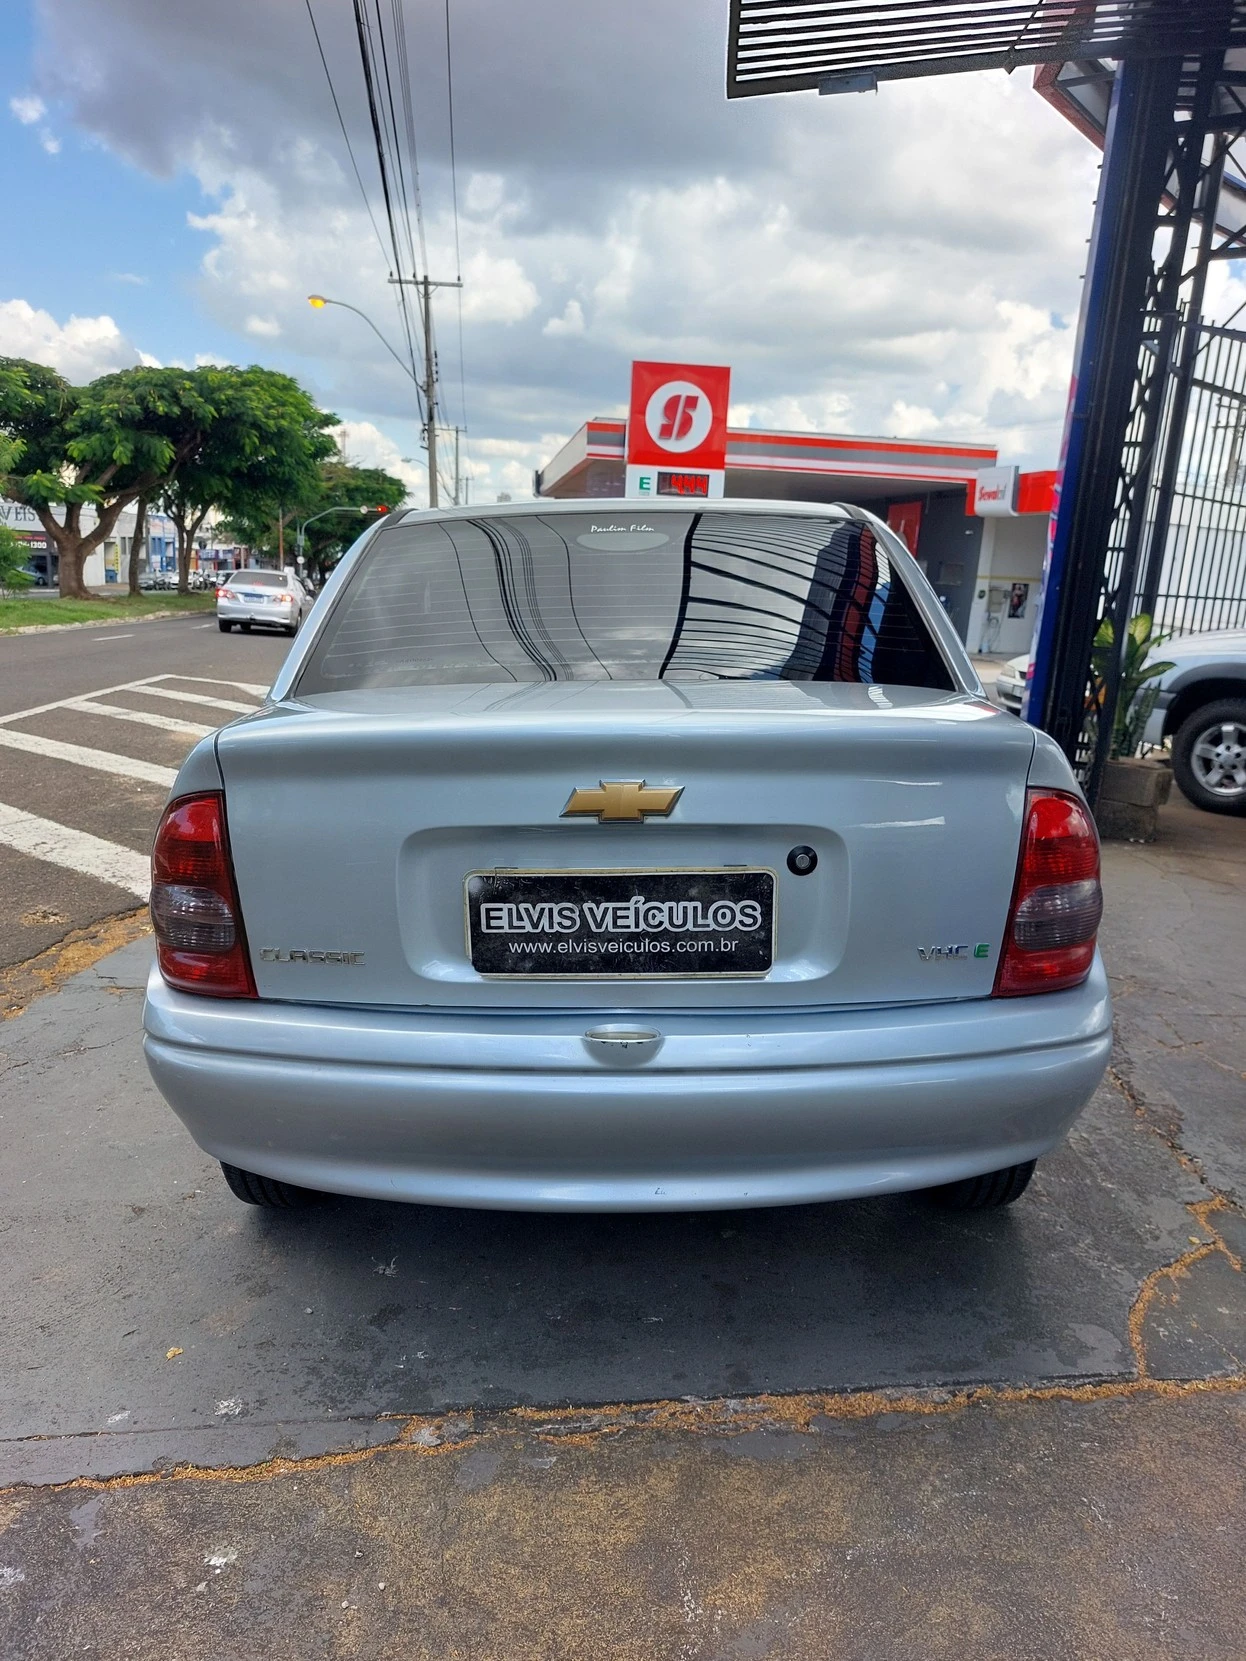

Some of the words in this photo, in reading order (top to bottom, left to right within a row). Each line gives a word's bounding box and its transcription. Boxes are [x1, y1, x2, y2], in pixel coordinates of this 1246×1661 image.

[480, 903, 580, 934] ELVIS
[583, 896, 762, 933] VEÍCULOS
[508, 939, 739, 954] www.elvisveiculos.com.br
[917, 944, 968, 960] VHC
[974, 942, 990, 958] E
[259, 947, 366, 965] CLASSIC
